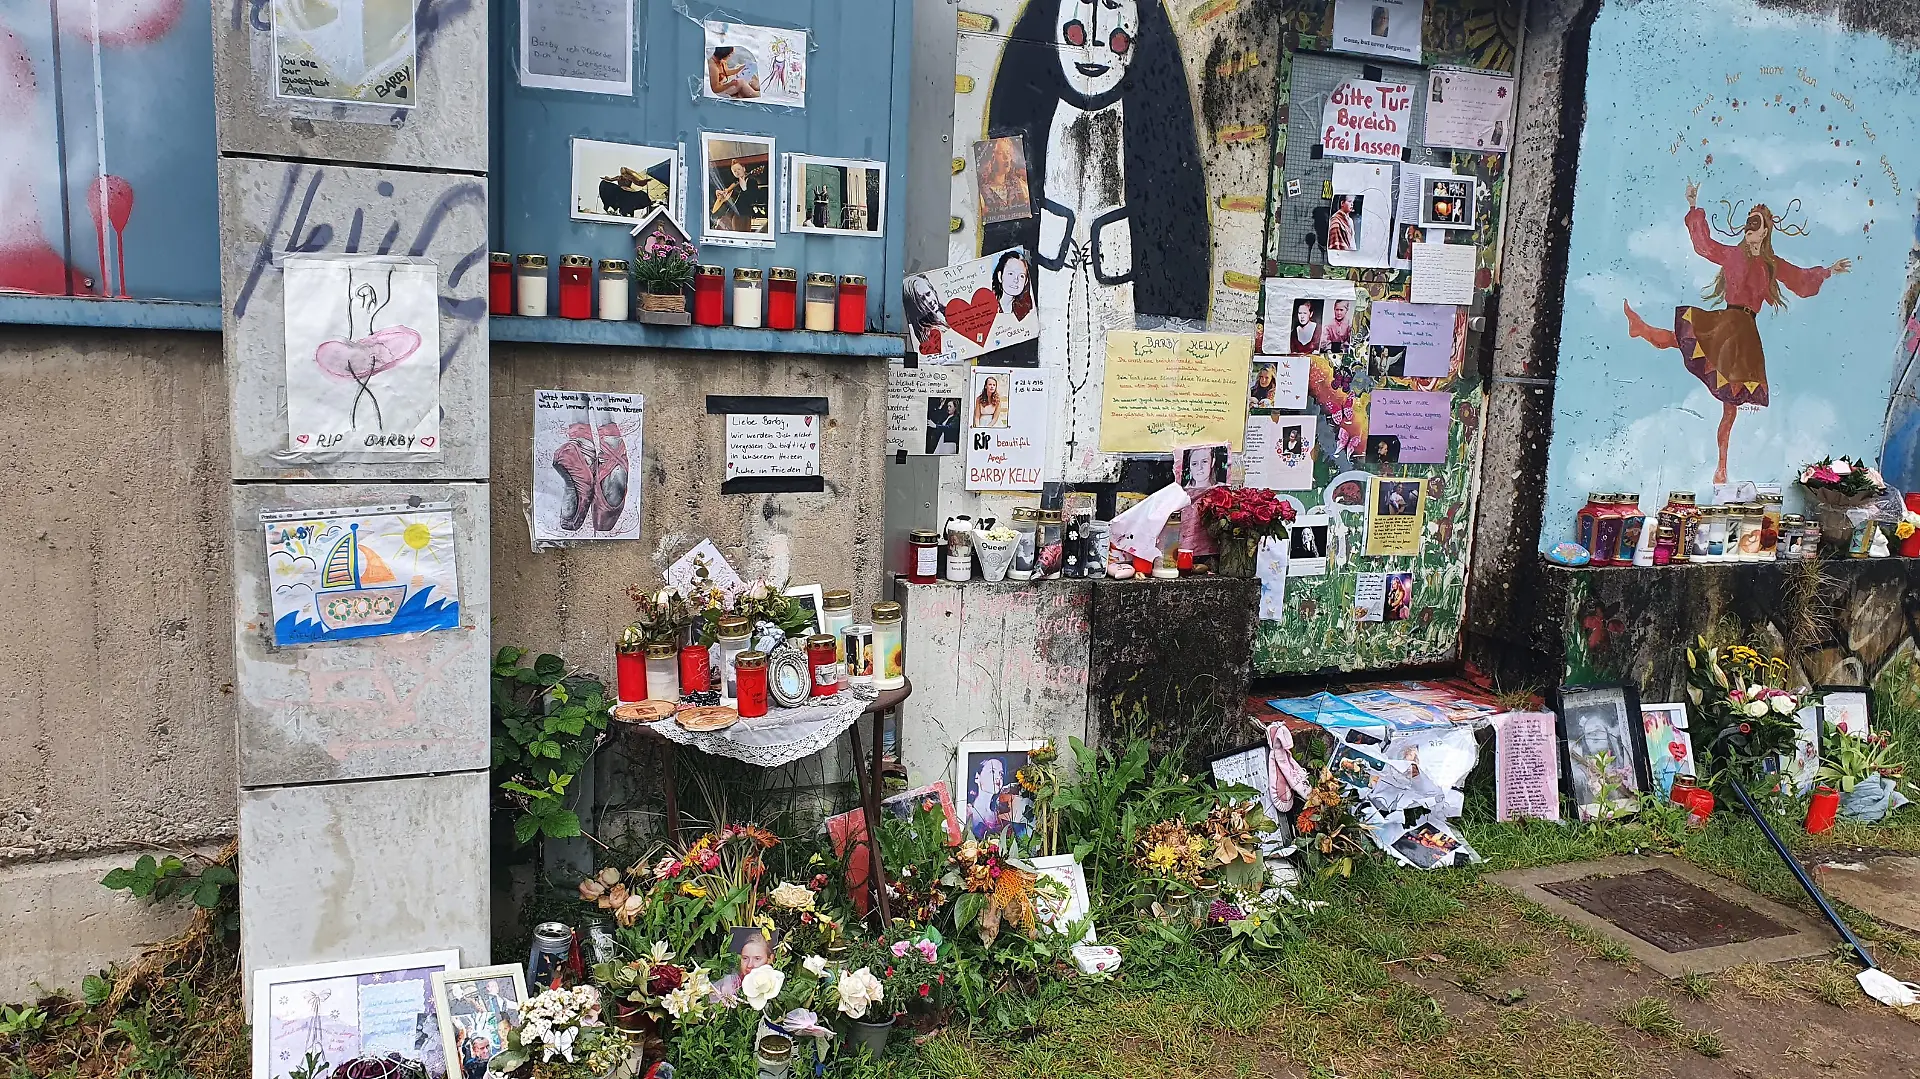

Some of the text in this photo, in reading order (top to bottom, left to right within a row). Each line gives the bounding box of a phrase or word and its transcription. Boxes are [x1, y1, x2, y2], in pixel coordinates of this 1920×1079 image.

[1360, 38, 1370, 46] but
[1386, 43, 1411, 53] forgotten
[300, 59, 318, 68] are
[282, 68, 300, 76] our
[281, 76, 330, 88] sweetest
[374, 66, 411, 98] BARBY
[284, 84, 316, 96] Angel
[1798, 66, 1818, 88] than
[1830, 88, 1856, 112] words
[1331, 83, 1373, 109] Bitte
[1338, 108, 1397, 132] Bereich
[1322, 125, 1401, 157] frei lassen
[943, 264, 963, 280] RIP
[1006, 327, 1026, 338] QUEEN
[1142, 336, 1222, 358] BARBY KELLY
[538, 392, 558, 402] Jetzt
[608, 395, 632, 404] Himmel
[538, 402, 551, 410] und
[552, 402, 564, 410] für
[732, 416, 758, 426] Liebe
[316, 433, 416, 448] RIP BARBY
[780, 442, 791, 450] bist
[792, 442, 807, 450] tief
[974, 432, 1031, 450] RIP beautiful
[735, 465, 801, 474] Ruhe in Frieden
[970, 468, 1041, 487] BARBY KELLY
[981, 542, 1007, 552] Queen
